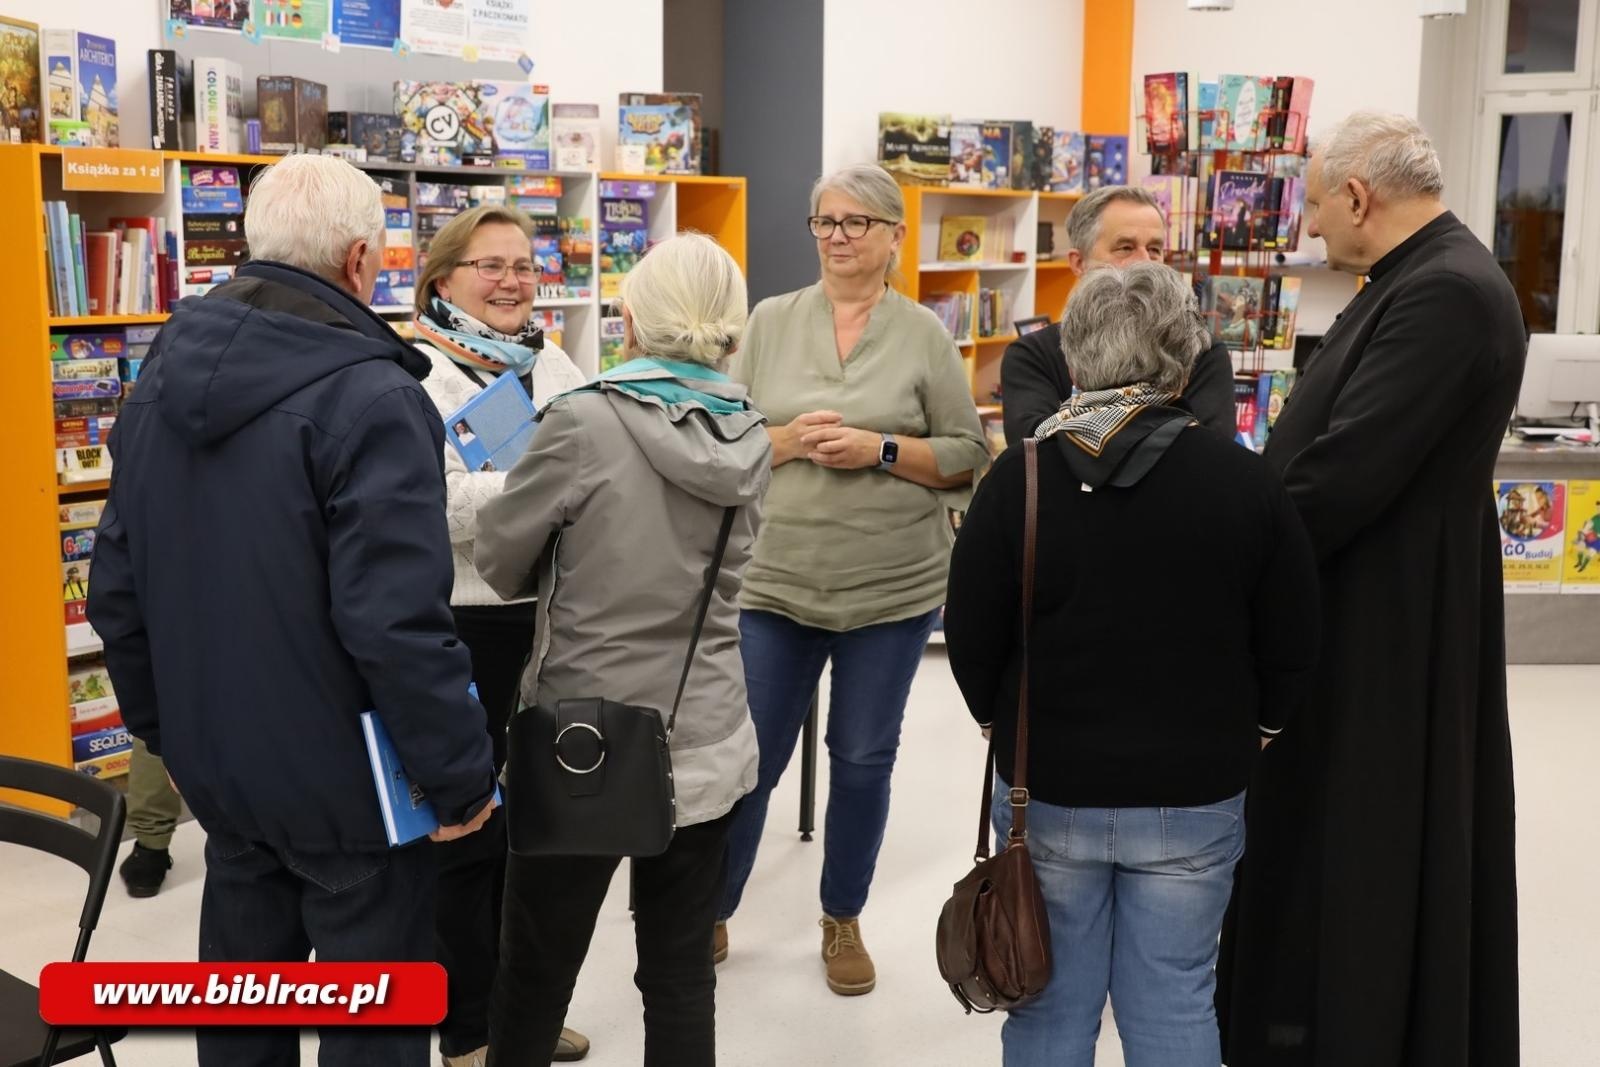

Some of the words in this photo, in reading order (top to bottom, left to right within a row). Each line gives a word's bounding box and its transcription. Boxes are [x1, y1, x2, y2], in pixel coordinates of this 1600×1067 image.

[207, 71, 218, 111] COLOUR
[208, 115, 219, 149] BRAIN
[431, 113, 452, 134] CV
[68, 162, 119, 177] Książka
[122, 167, 136, 176] za
[140, 165, 146, 176] 1
[149, 166, 160, 177] zł
[76, 447, 102, 461] BLOCK
[1504, 543, 1525, 556] GO
[89, 732, 133, 753] SEQUEN
[106, 757, 130, 771] COLO
